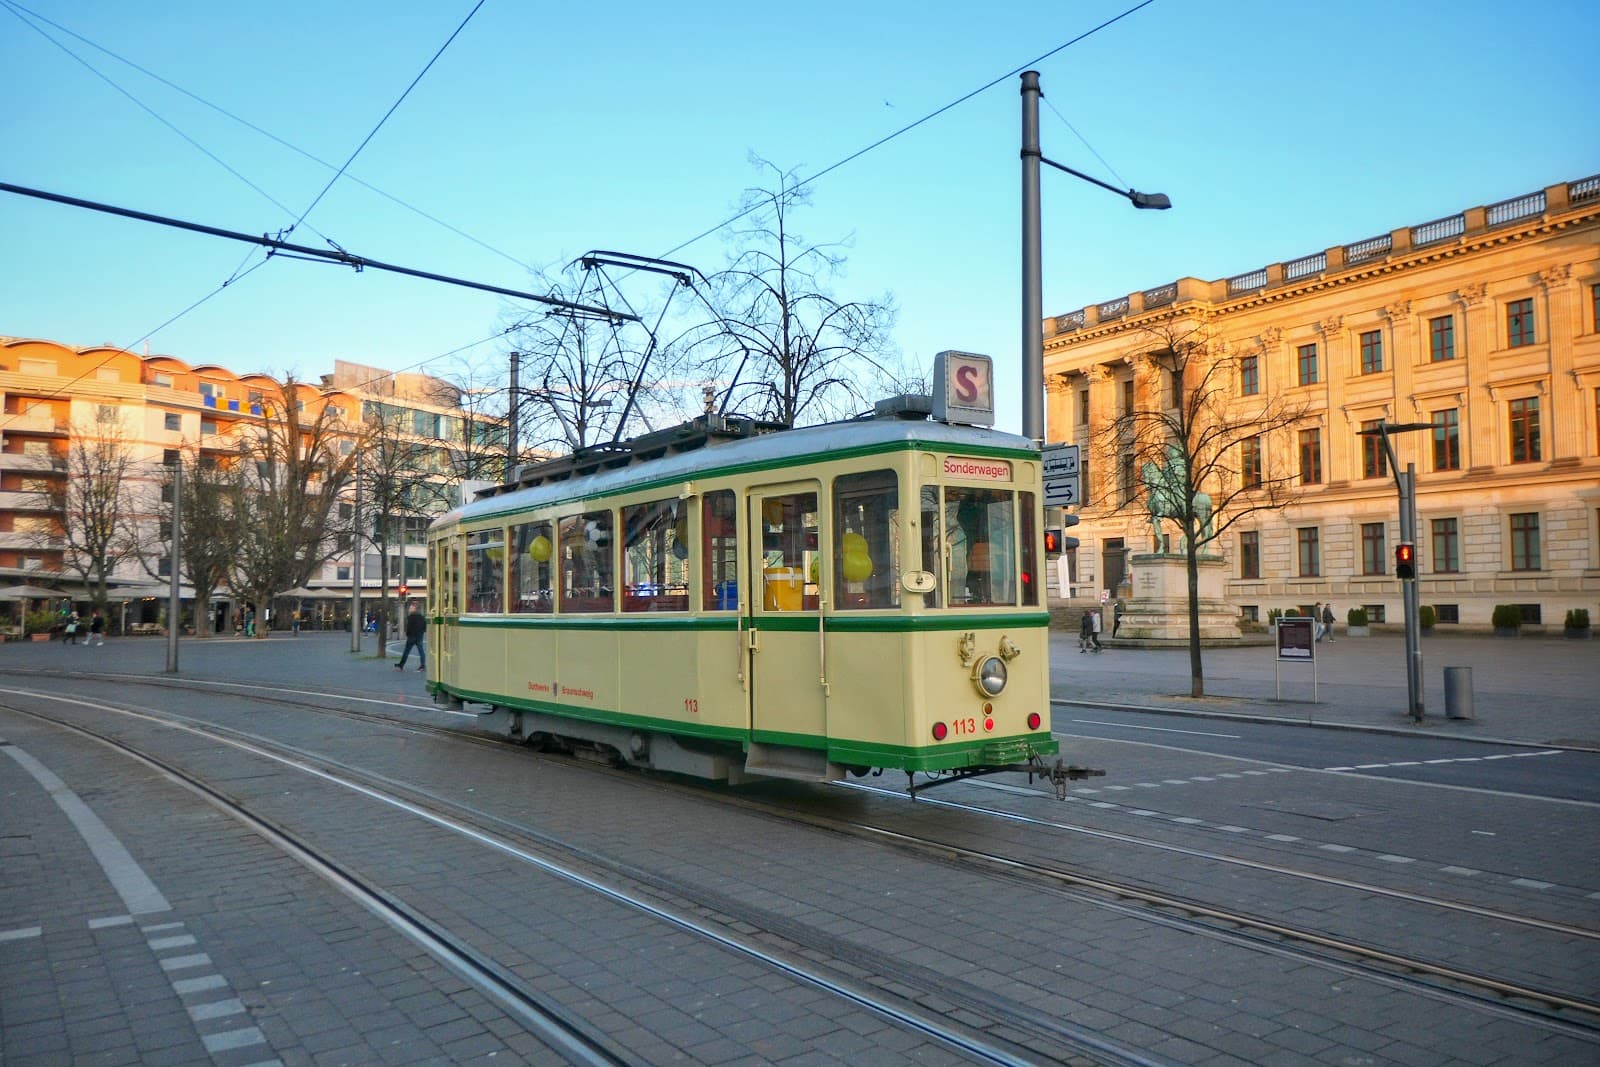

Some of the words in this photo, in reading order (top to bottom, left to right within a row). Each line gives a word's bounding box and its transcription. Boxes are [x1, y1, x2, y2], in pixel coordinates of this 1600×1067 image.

[956, 365, 978, 402] S
[944, 460, 1008, 478] Sonderwagen
[684, 698, 698, 713] 113
[952, 718, 976, 735] 113
